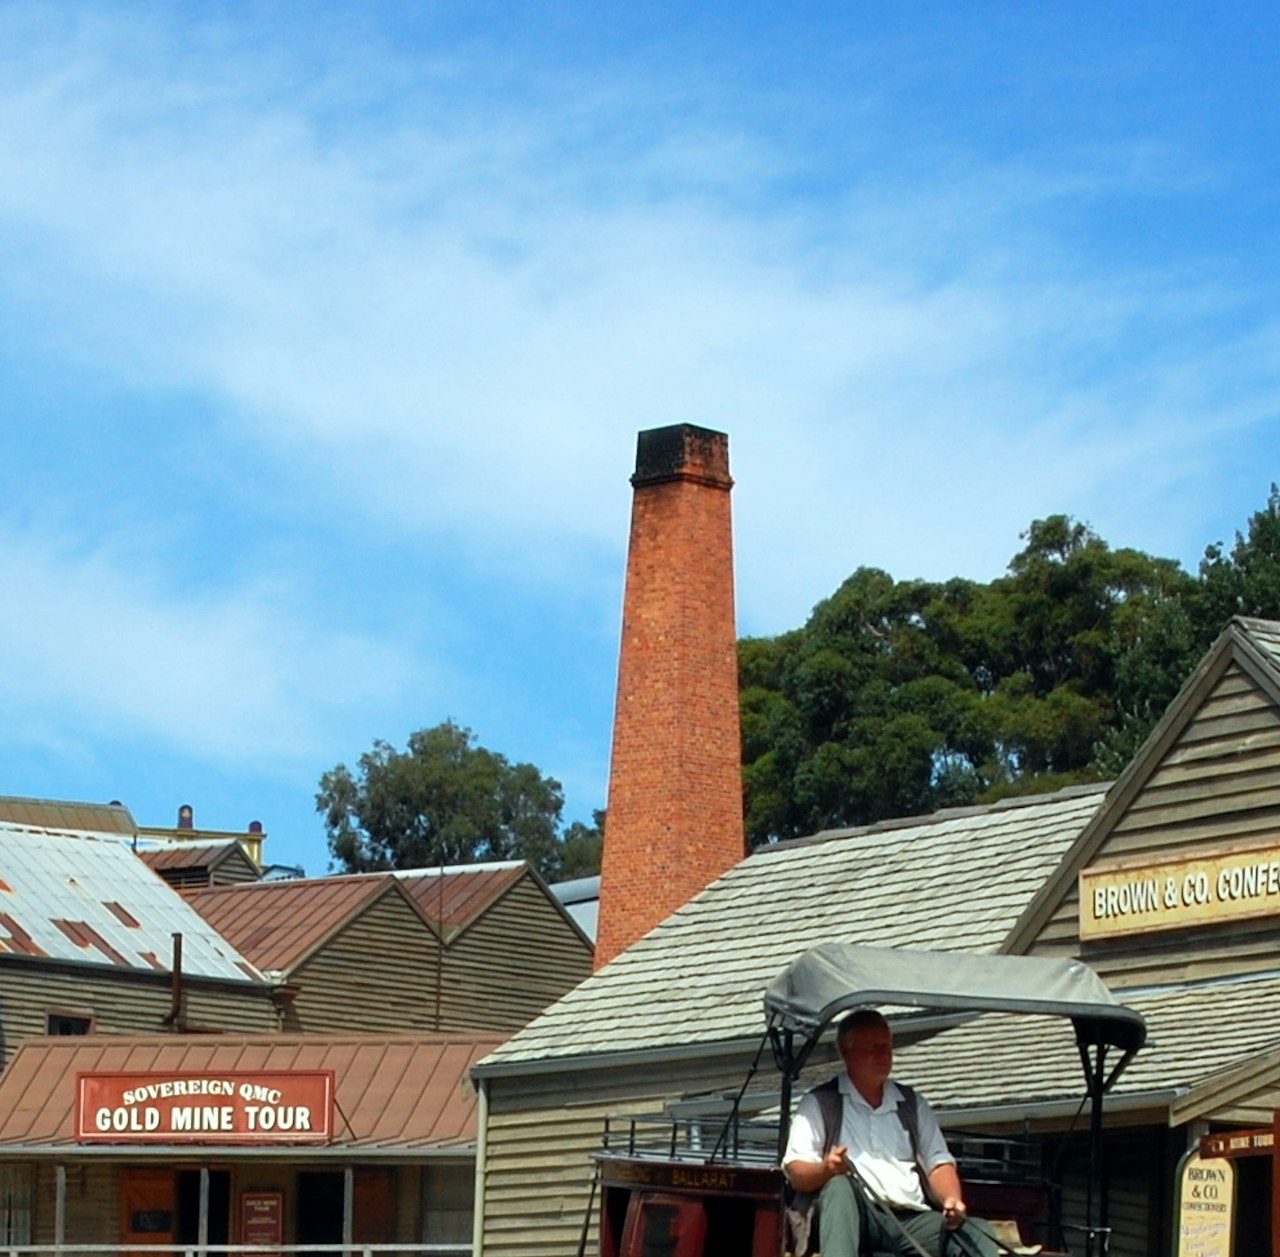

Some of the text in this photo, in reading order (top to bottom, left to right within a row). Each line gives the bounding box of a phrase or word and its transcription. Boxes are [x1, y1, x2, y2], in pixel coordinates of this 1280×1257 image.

[1093, 879, 1159, 919] BROWN
[1165, 876, 1178, 909] &
[1181, 872, 1210, 907] CO.
[122, 1080, 282, 1105] SOVEREIGN QMC
[95, 1106, 311, 1131] GOLD MINE TOUR
[671, 1169, 737, 1187] BALLARAT
[1188, 1167, 1225, 1183] BROWN
[1191, 1185, 1202, 1198] &
